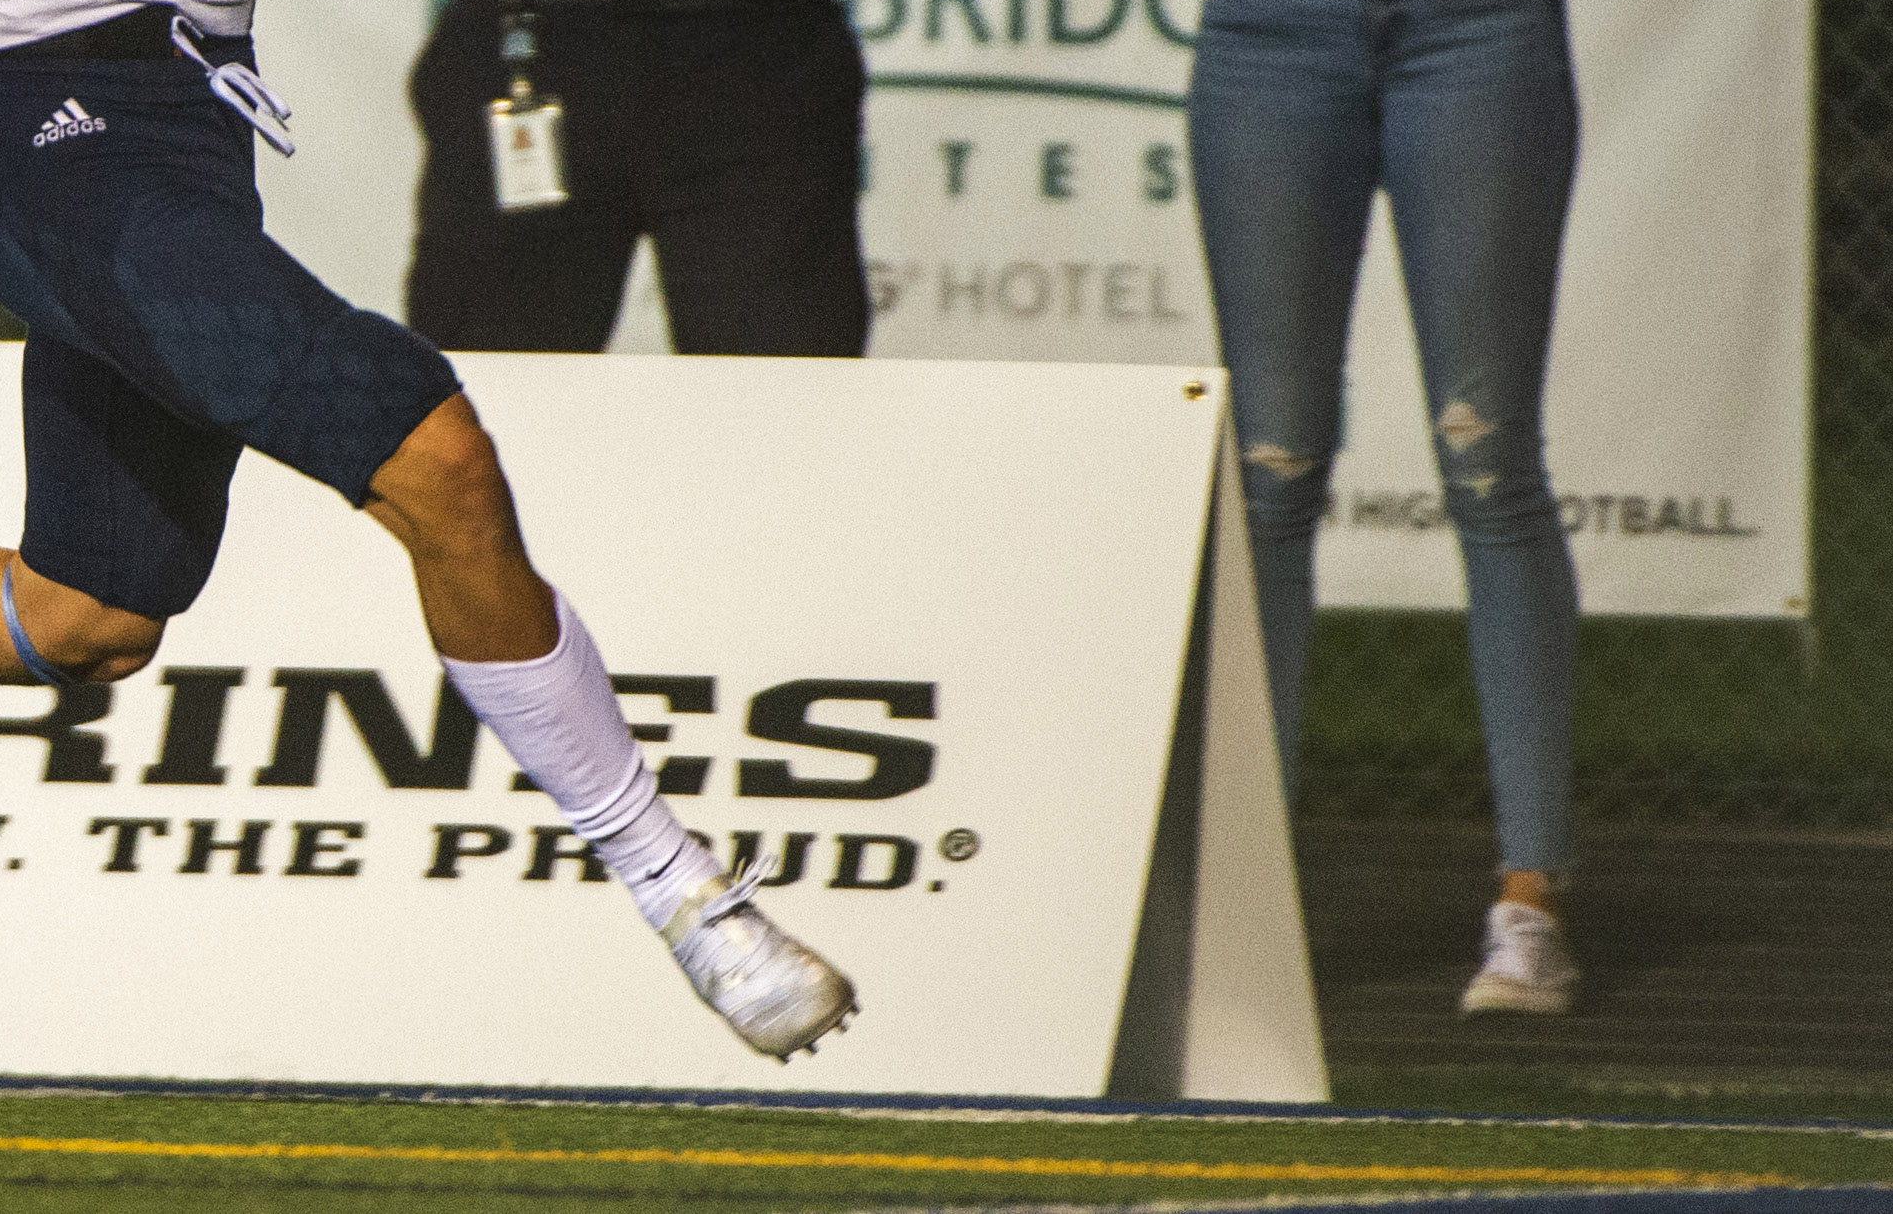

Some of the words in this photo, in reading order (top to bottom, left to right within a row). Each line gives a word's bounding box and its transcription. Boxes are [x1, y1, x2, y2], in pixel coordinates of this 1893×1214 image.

[33, 117, 107, 147] adidas
[936, 259, 1190, 324] HOTEL
[1350, 490, 1448, 531] HIG
[89, 815, 369, 878] THE
